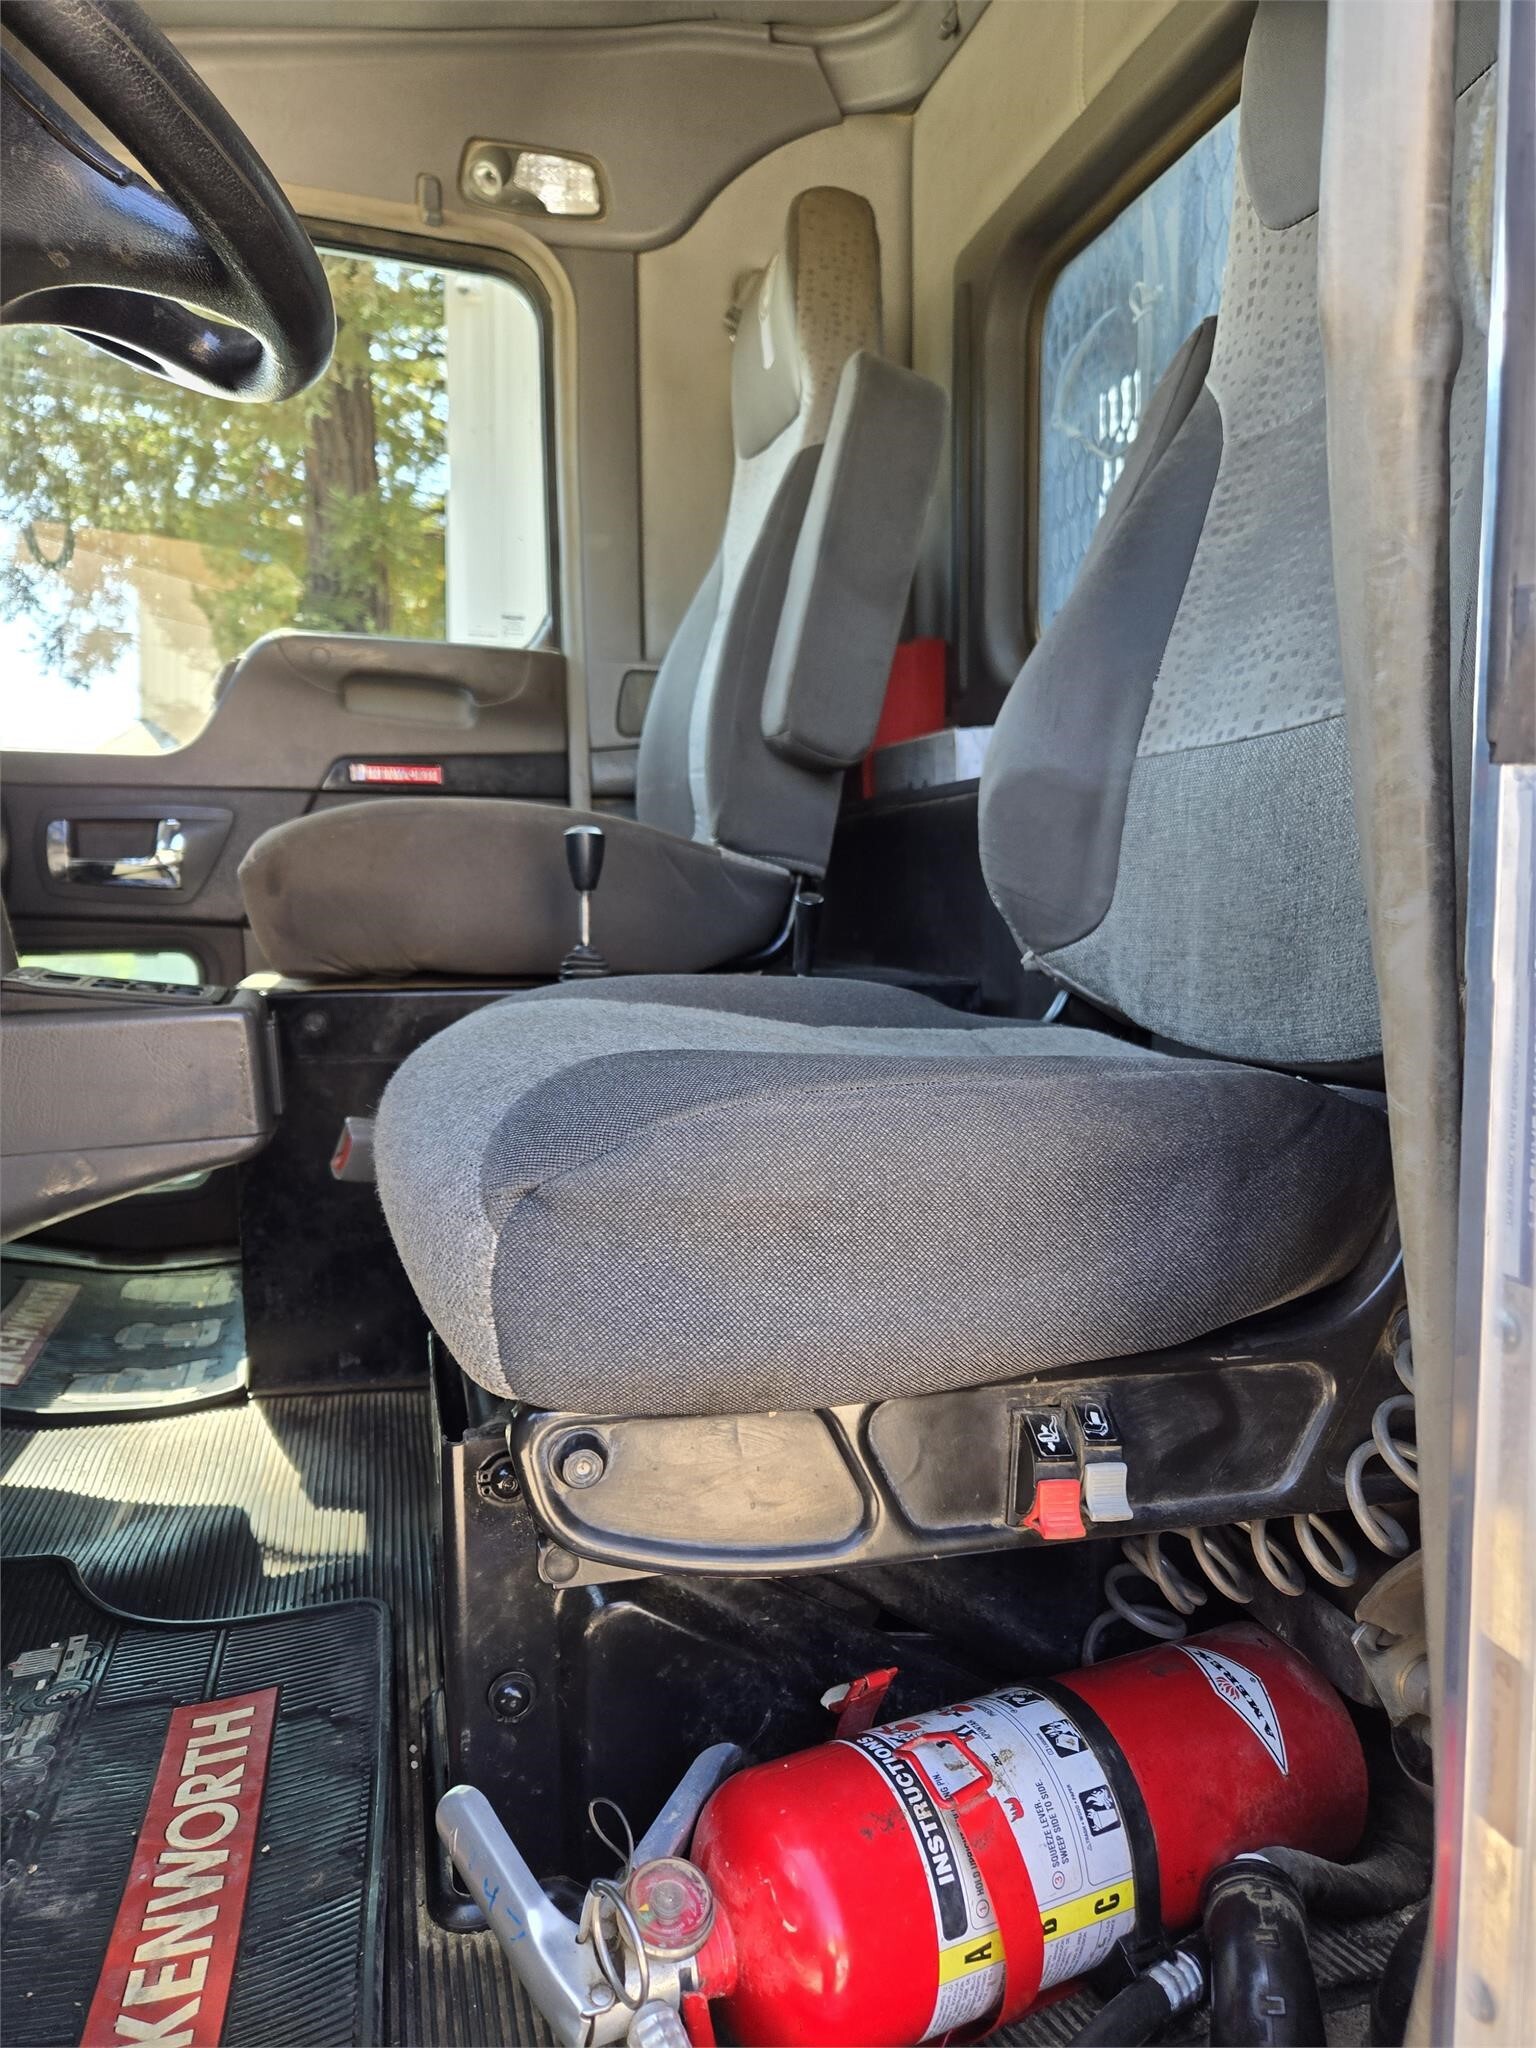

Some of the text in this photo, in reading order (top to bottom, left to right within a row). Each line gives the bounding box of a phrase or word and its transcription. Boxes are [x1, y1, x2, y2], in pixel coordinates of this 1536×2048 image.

[1194, 1650, 1276, 1740] AMEREX
[857, 1736, 956, 1886] INSTRUCTIONS
[1034, 1799, 1049, 1829] LEVER.
[1035, 1779, 1070, 1865] SWEEP SIDE TO SIDE.
[1044, 1829, 1060, 1868] SQUEEZE
[114, 1706, 256, 2048] KENWORTH
[973, 1871, 985, 1896] HOLD
[965, 1942, 992, 1964] A
[1093, 1893, 1120, 1915] C
